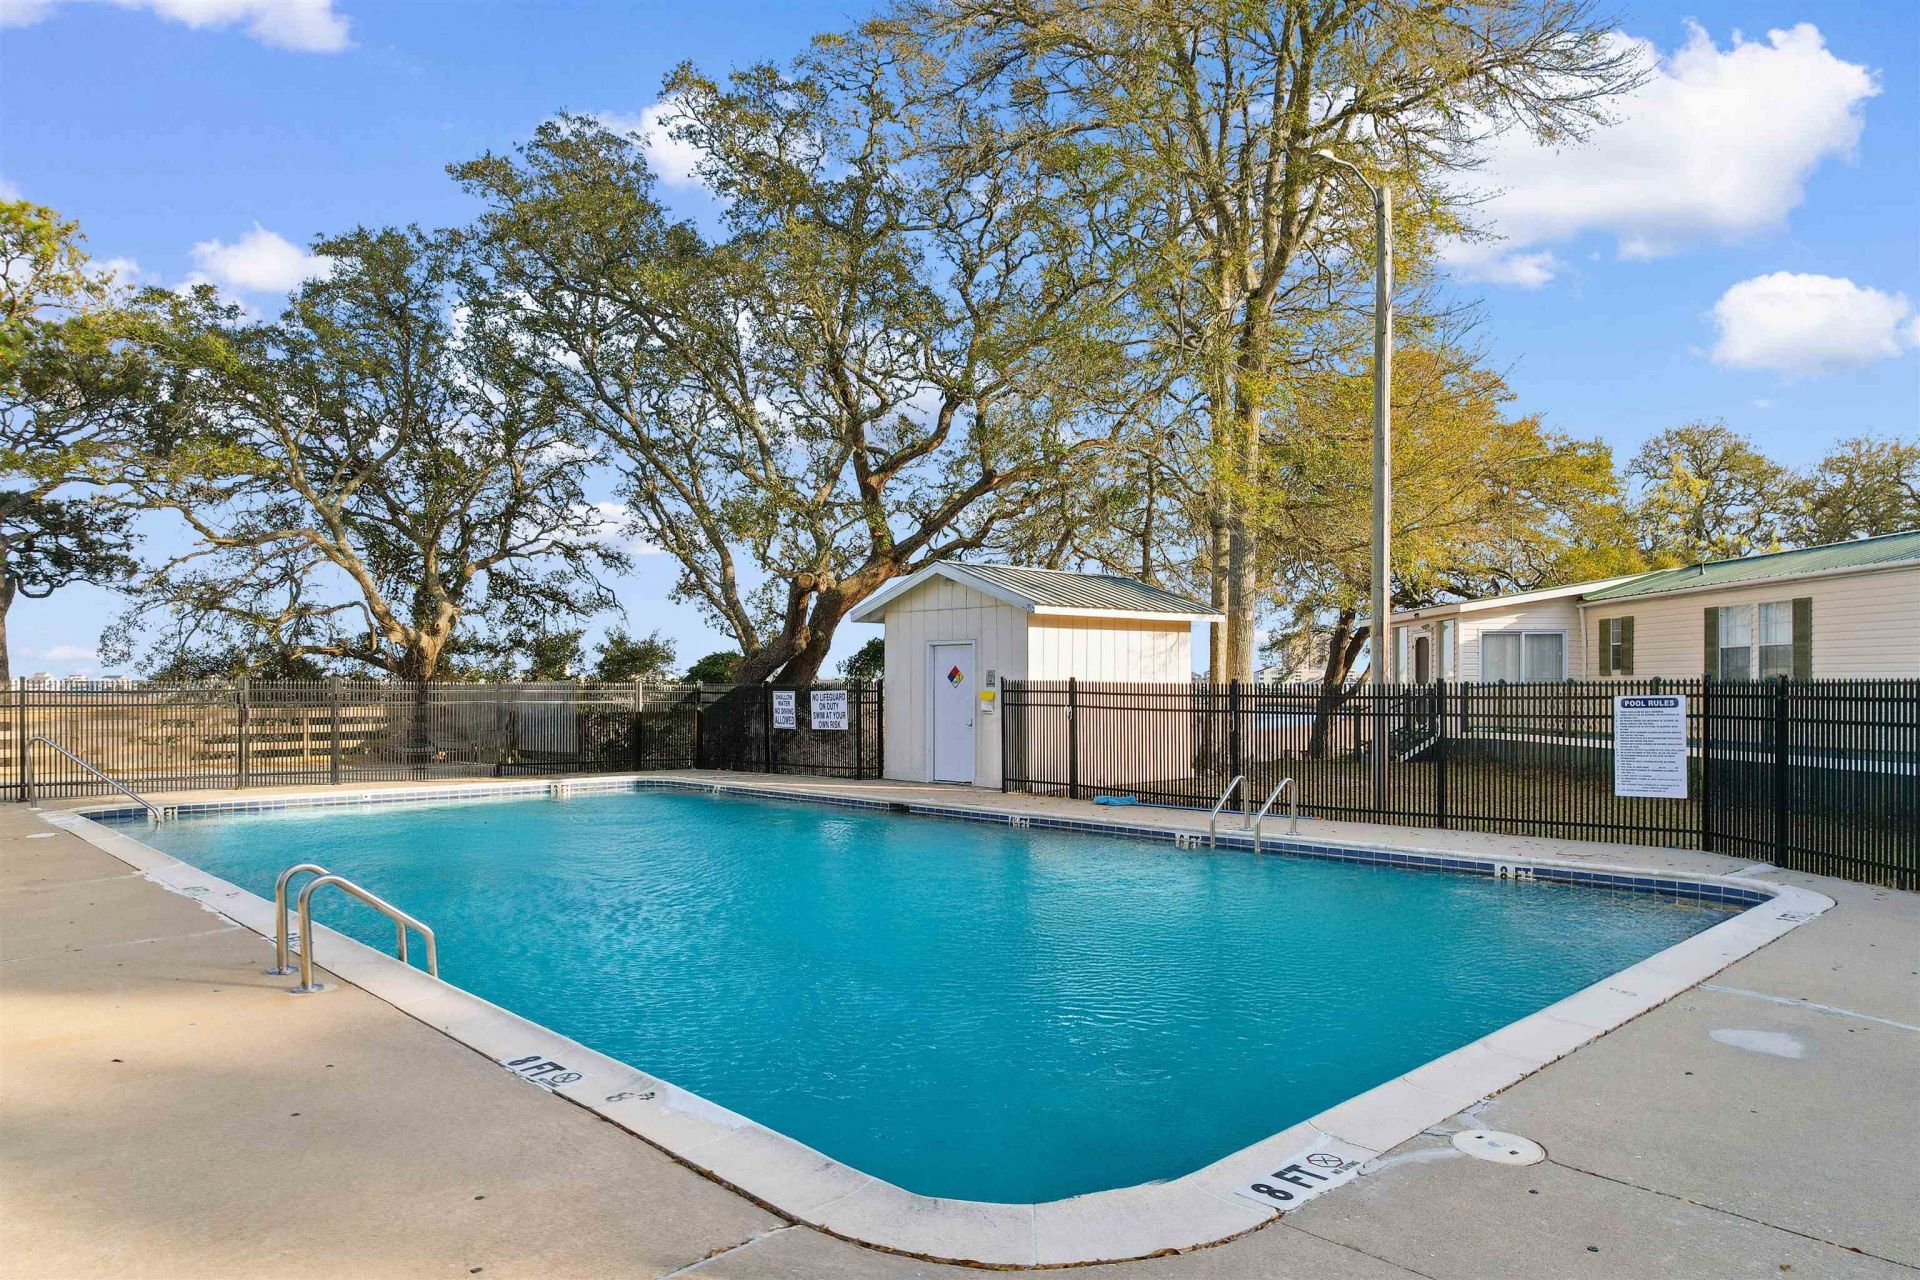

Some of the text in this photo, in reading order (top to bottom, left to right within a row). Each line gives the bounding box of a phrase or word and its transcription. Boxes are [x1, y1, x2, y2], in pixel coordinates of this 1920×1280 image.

[812, 693, 845, 701] NO LIFEGUARD
[775, 716, 794, 724] ALLOWED
[507, 1055, 567, 1078] 8 FT
[1250, 1164, 1329, 1201] 8 FT
